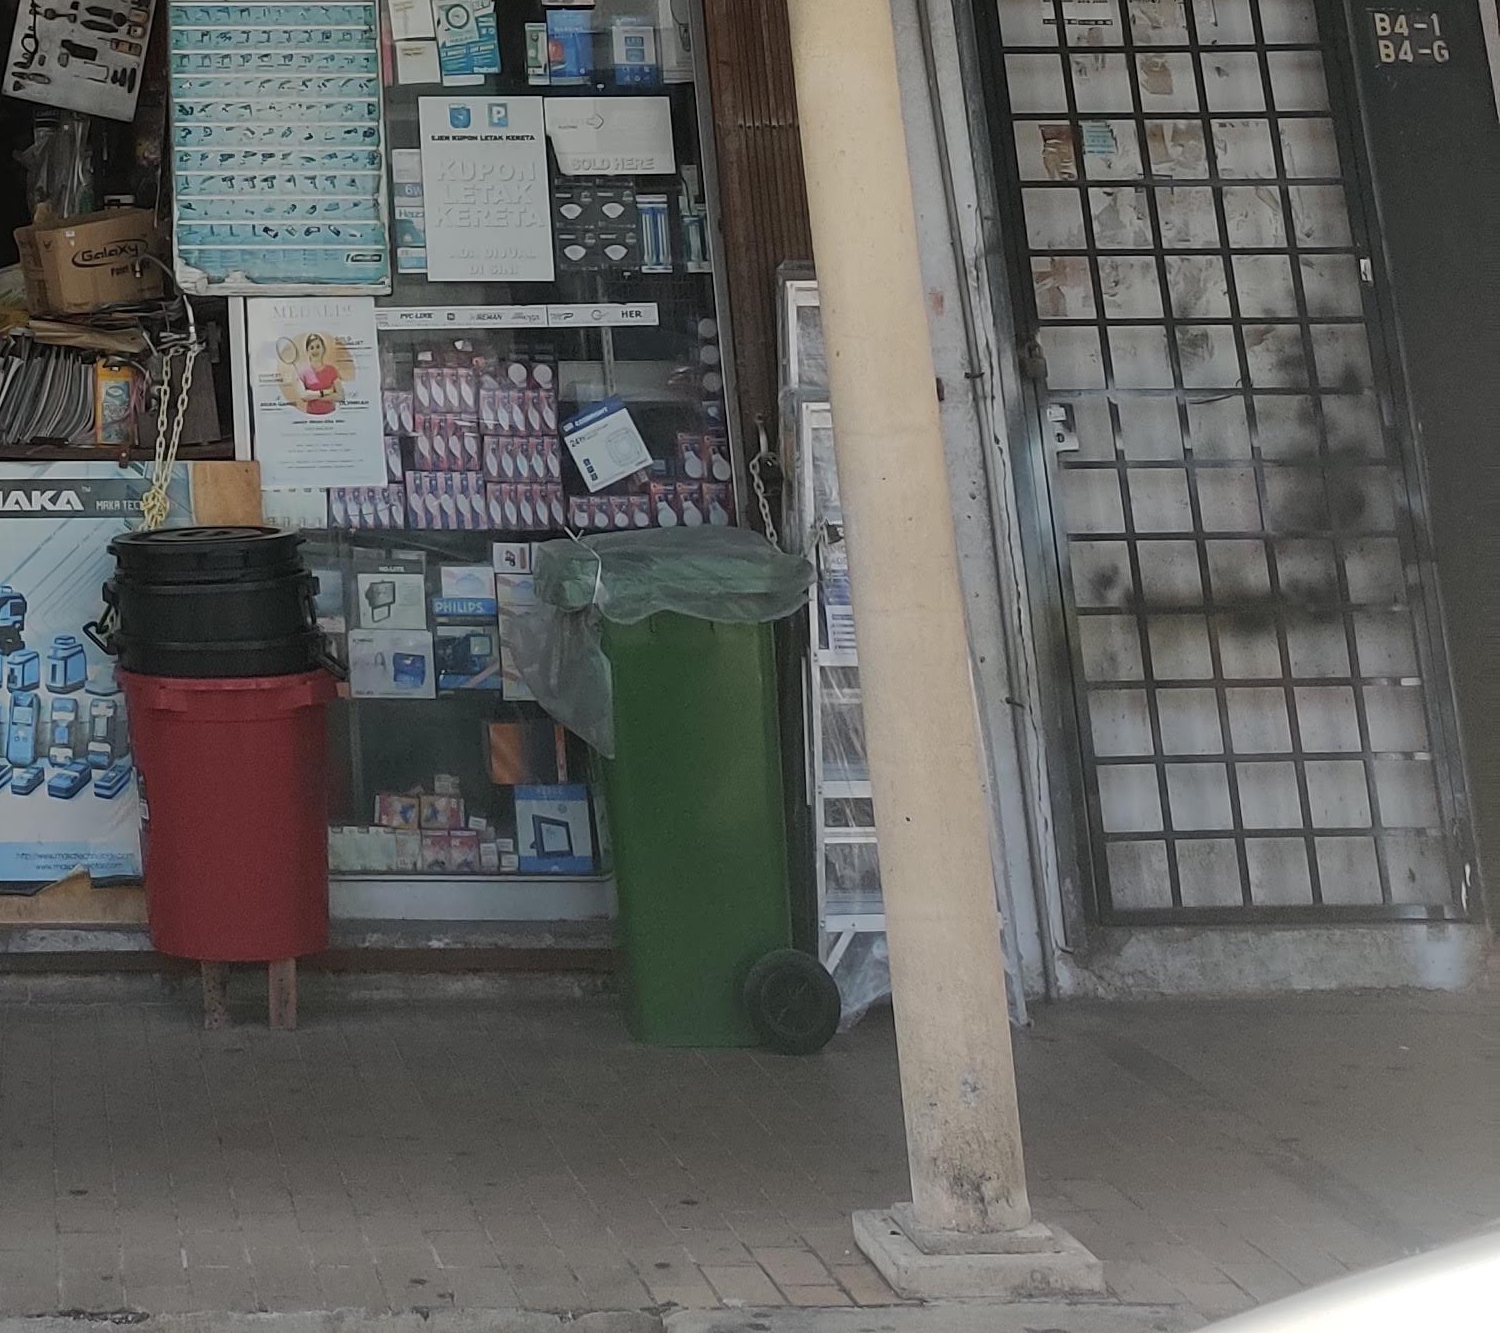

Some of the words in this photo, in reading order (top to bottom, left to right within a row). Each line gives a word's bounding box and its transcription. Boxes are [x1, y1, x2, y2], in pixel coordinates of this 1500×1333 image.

[1374, 13, 1440, 36] B4-1
[1379, 39, 1450, 63] B4-G
[437, 159, 537, 182] KUPON
[443, 184, 533, 205] LETAK
[435, 208, 548, 228] KERETA
[434, 601, 484, 614] PHILIPS
